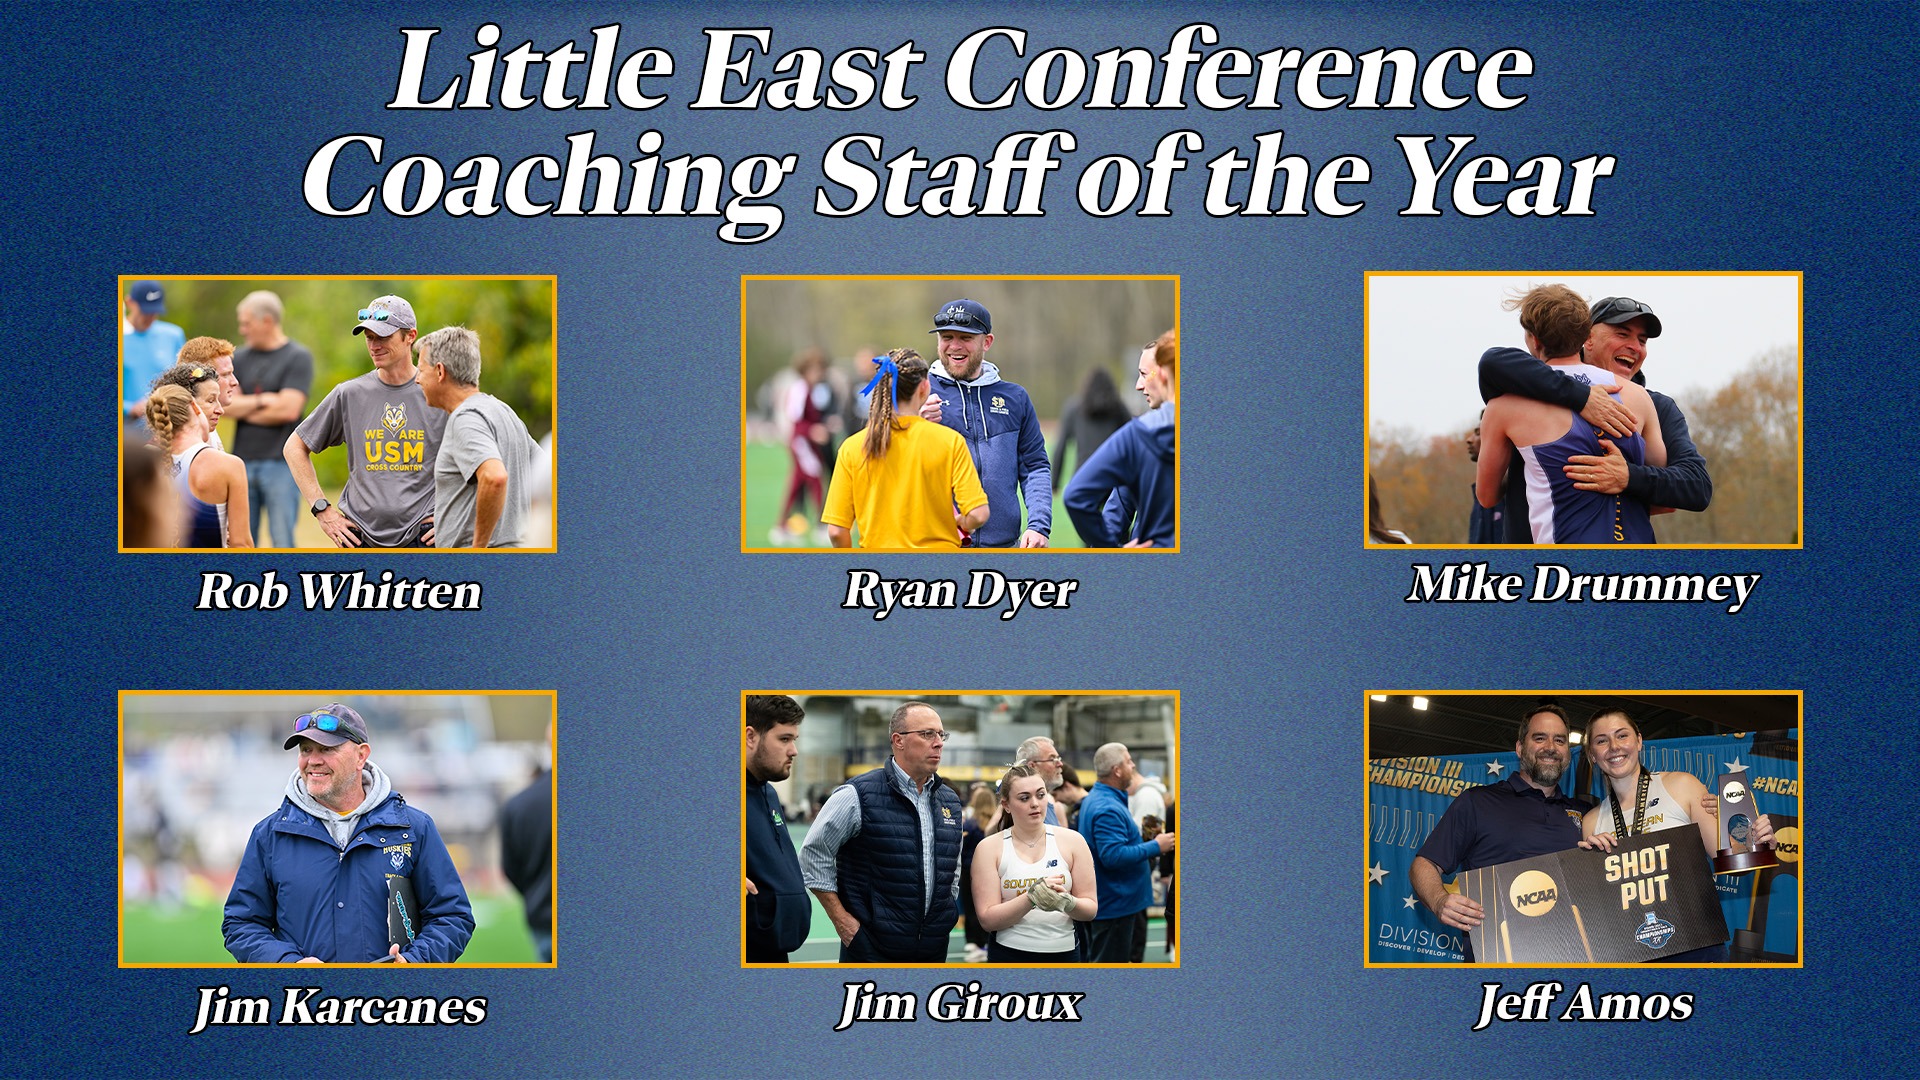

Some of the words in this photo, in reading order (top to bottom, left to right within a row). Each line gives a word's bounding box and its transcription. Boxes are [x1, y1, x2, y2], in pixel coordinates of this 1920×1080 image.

[364, 429, 385, 440] WE
[399, 429, 425, 440] ARE
[365, 441, 425, 463] USM
[365, 463, 388, 472] CROSS
[389, 463, 423, 472] COUNTRY
[1442, 760, 1464, 779] III
[1752, 776, 1798, 797] #NCA
[1605, 843, 1670, 882] SHOT
[1517, 888, 1557, 908] NCAA
[1621, 874, 1669, 911] PUT
[1715, 885, 1738, 894] DICATE
[1379, 923, 1464, 953] DIVISION
[1378, 940, 1411, 951] DISCOVER
[1416, 947, 1446, 957] DEVELOP
